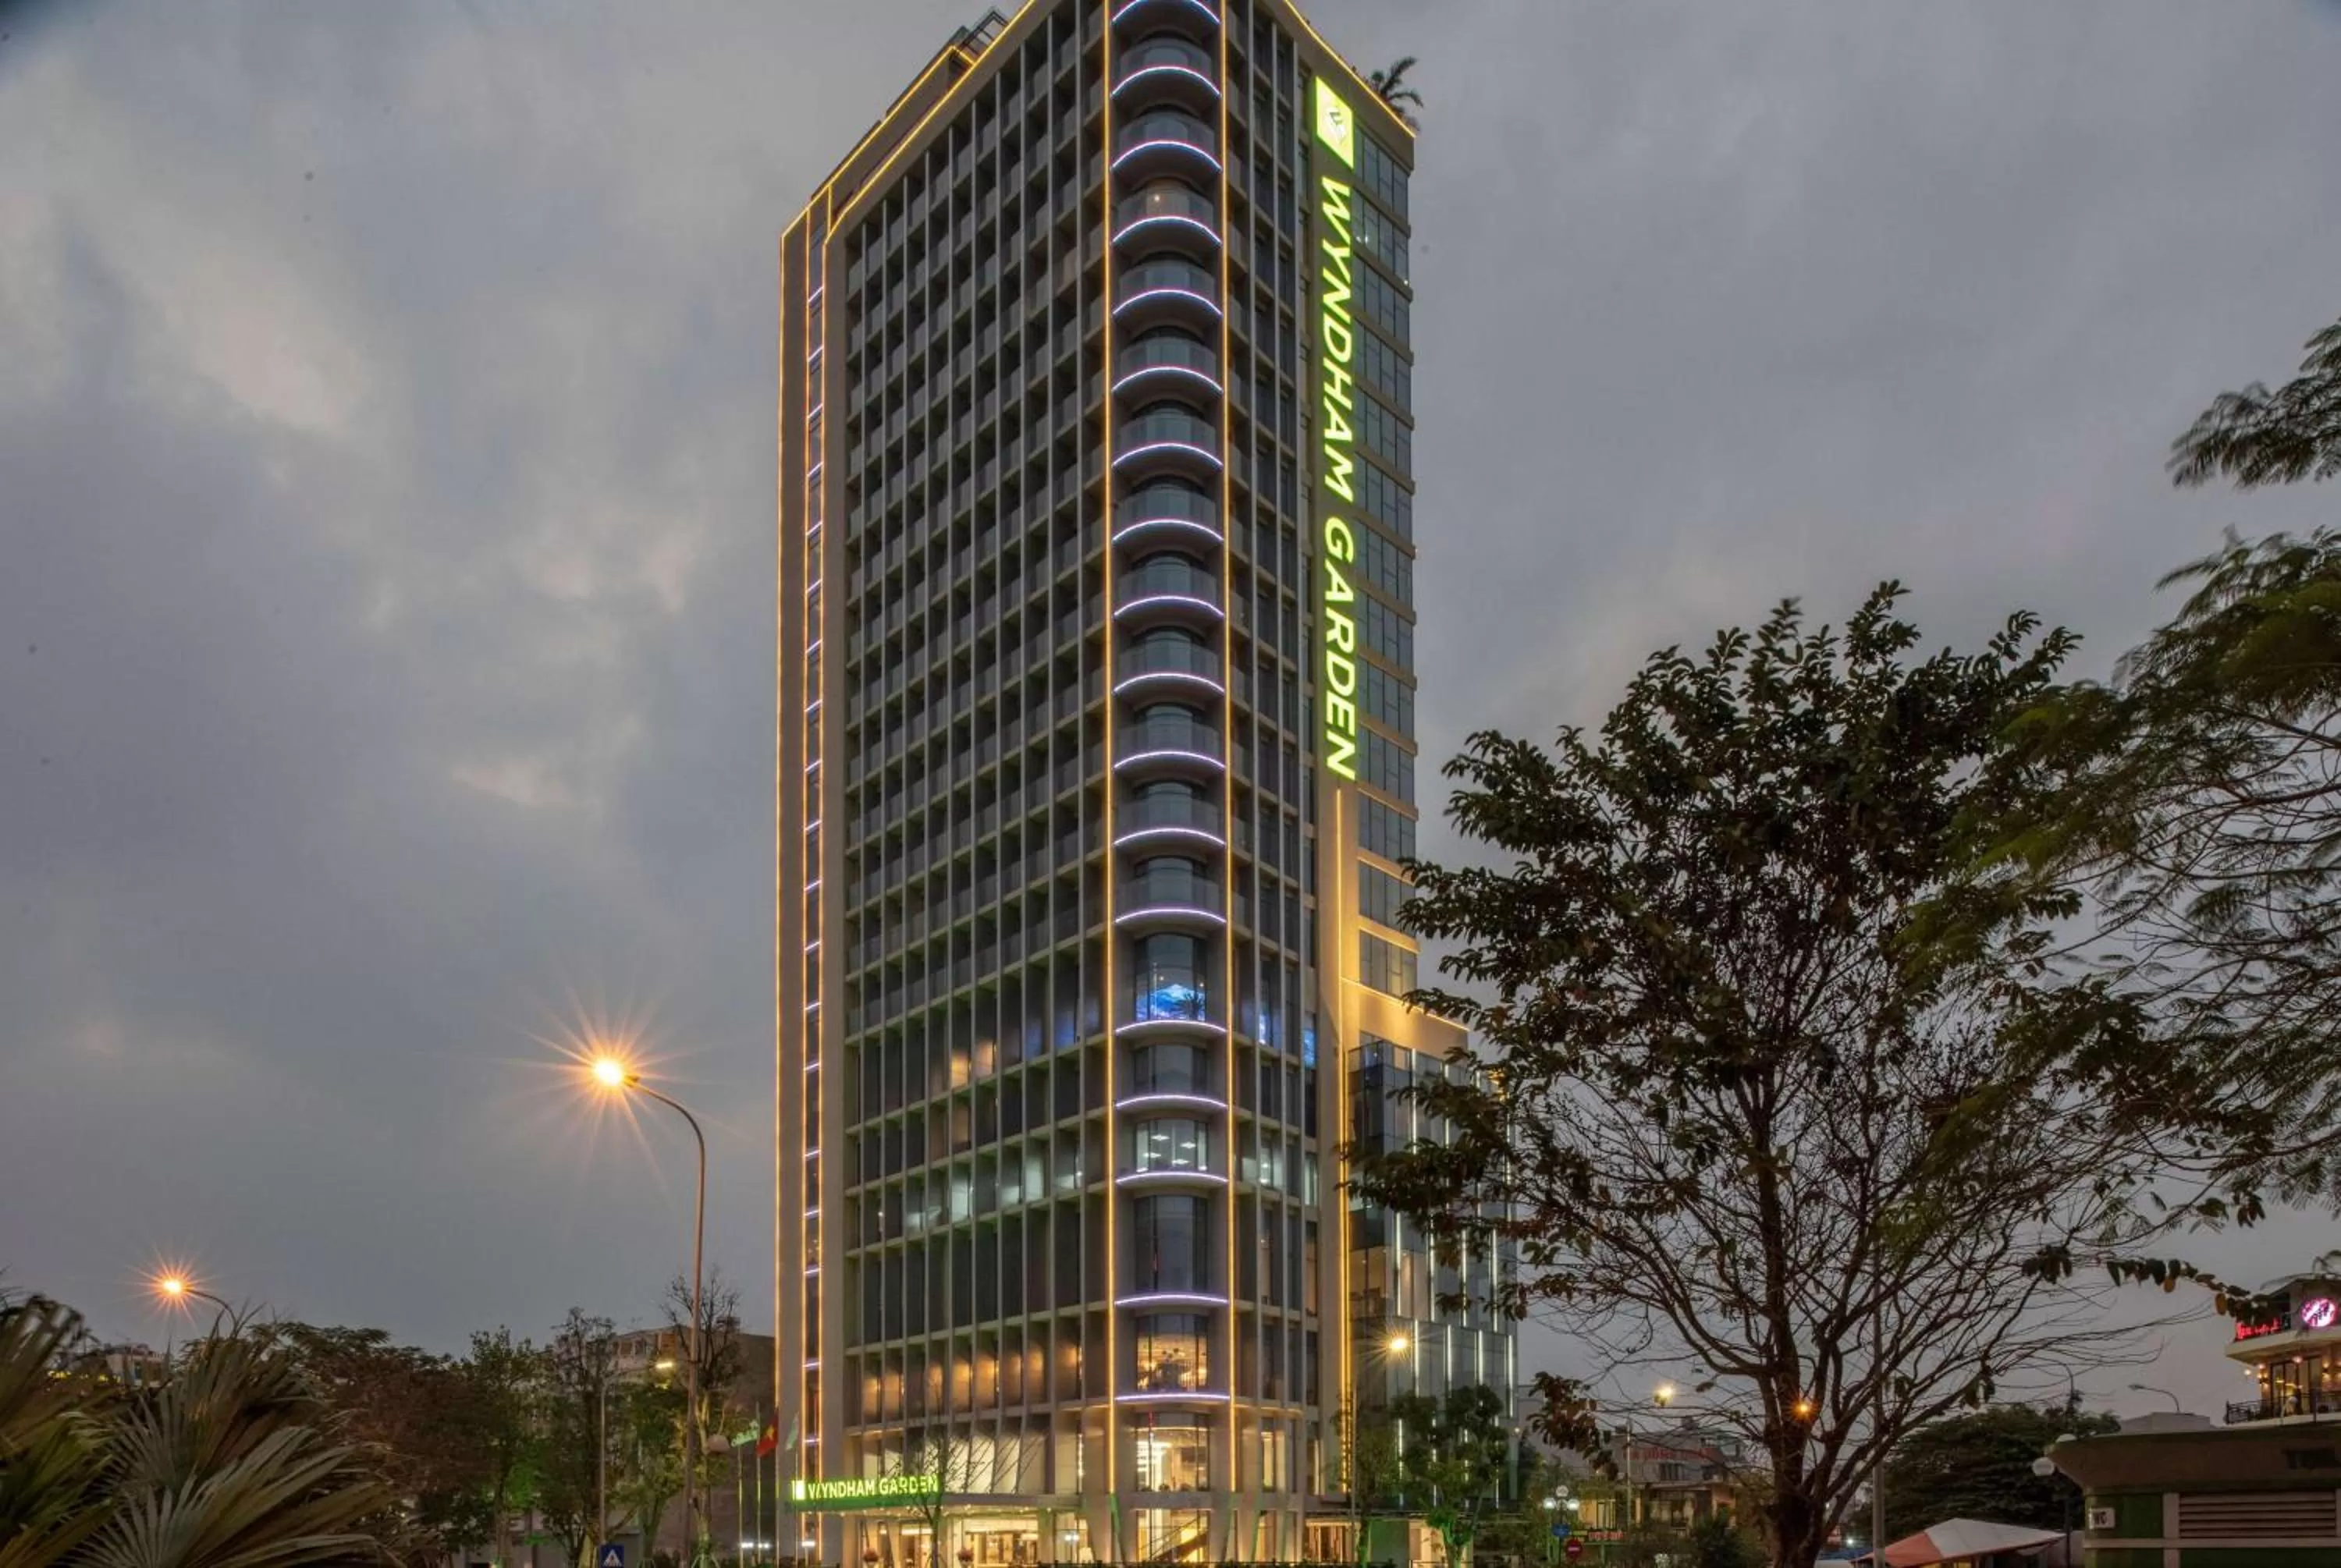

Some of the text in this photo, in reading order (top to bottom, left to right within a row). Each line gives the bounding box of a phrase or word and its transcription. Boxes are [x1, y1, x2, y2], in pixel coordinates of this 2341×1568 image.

[1321, 176, 1354, 502] WYNDHAM
[1324, 516, 1355, 781] GARDEN
[808, 1474, 939, 1499] WYNDHAM GARDEN
